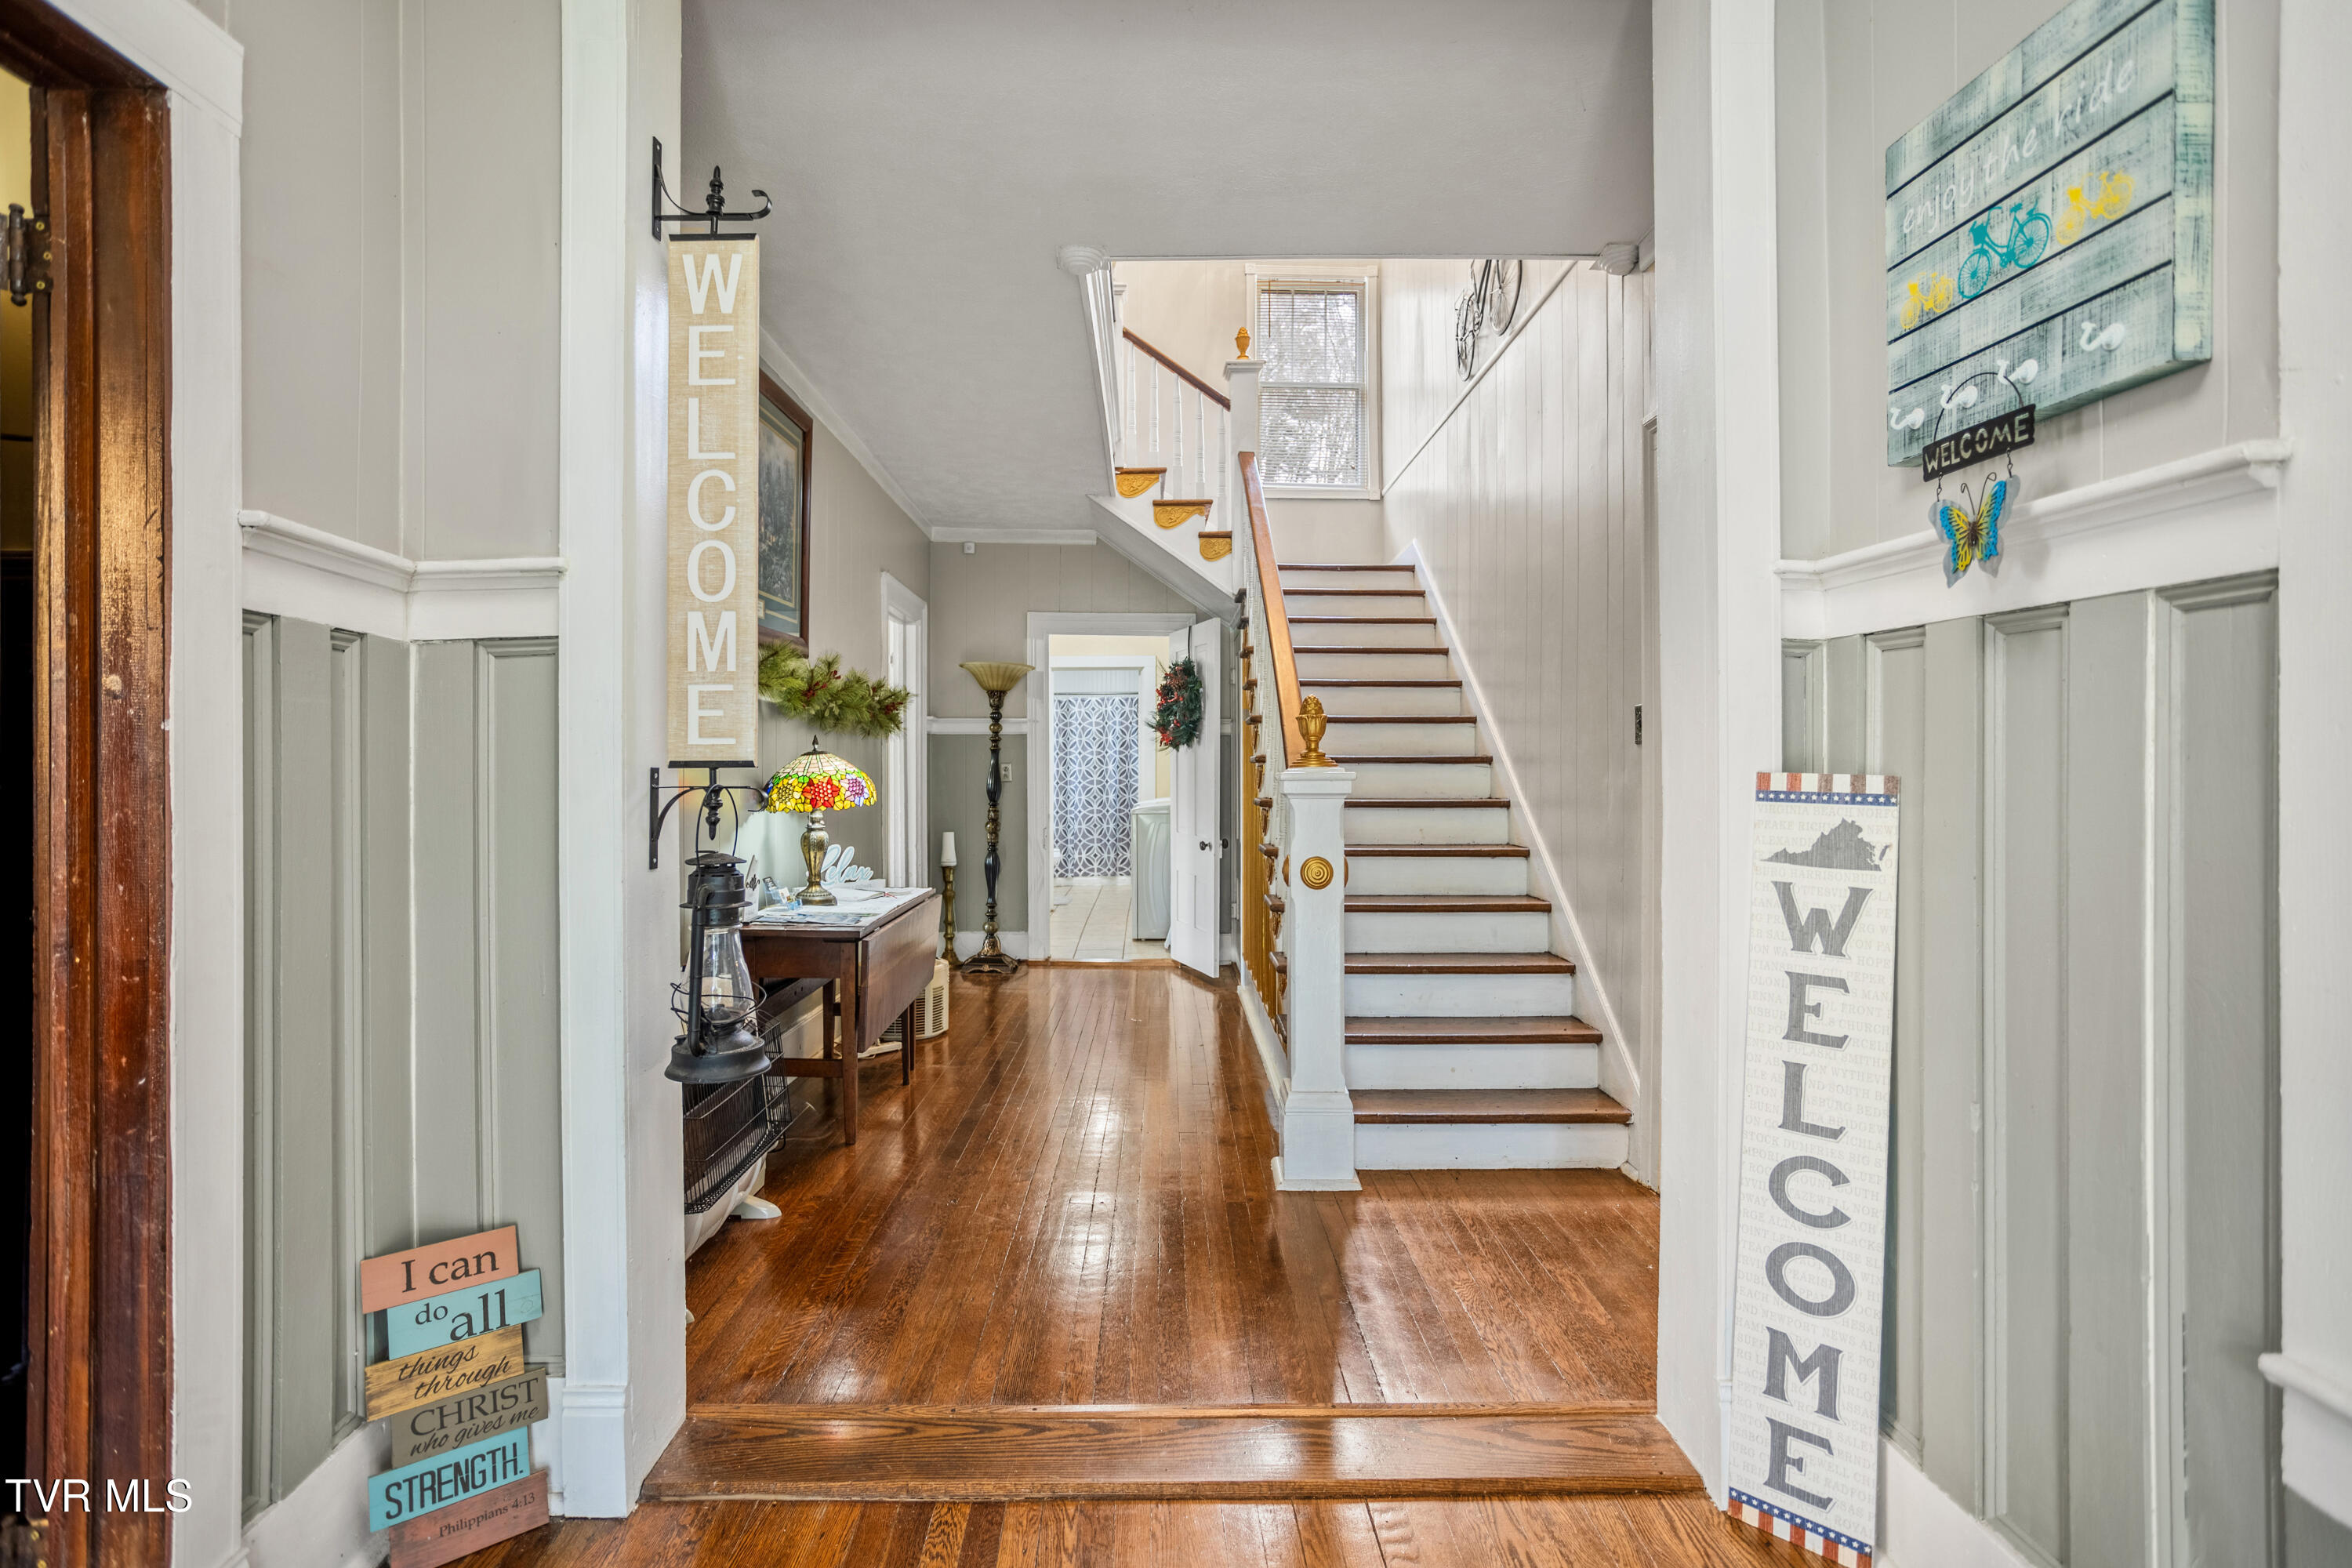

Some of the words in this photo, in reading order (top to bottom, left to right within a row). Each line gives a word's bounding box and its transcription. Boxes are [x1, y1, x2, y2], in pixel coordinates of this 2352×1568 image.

[1903, 176, 1975, 234] enjoy
[1981, 126, 2039, 183] the
[2053, 60, 2135, 137] ride
[1925, 412, 2030, 474] WELCOME
[683, 253, 743, 746] WELCOME
[1756, 804, 1809, 815] VIRGINIA
[1813, 805, 1854, 817] BEACH
[1790, 868, 1886, 885] HARRISONBURG
[1787, 1042, 1837, 1061] PULASKI
[1783, 1138, 1845, 1161] DUMFRIES
[1762, 880, 1875, 1513] WELCOME
[401, 1259, 416, 1293] I
[429, 1250, 499, 1285] can
[415, 1302, 448, 1325] do
[450, 1288, 510, 1341] all
[398, 1345, 479, 1381] things
[414, 1356, 512, 1399] through
[410, 1377, 539, 1436] CHRIST
[1756, 1402, 1832, 1439] WINCHESTER
[410, 1432, 448, 1457] who
[452, 1415, 507, 1450] gives
[510, 1405, 540, 1425] me
[385, 1443, 524, 1519] STRENGTH.
[439, 1504, 509, 1538] Philippians
[511, 1492, 535, 1509] 4:13
